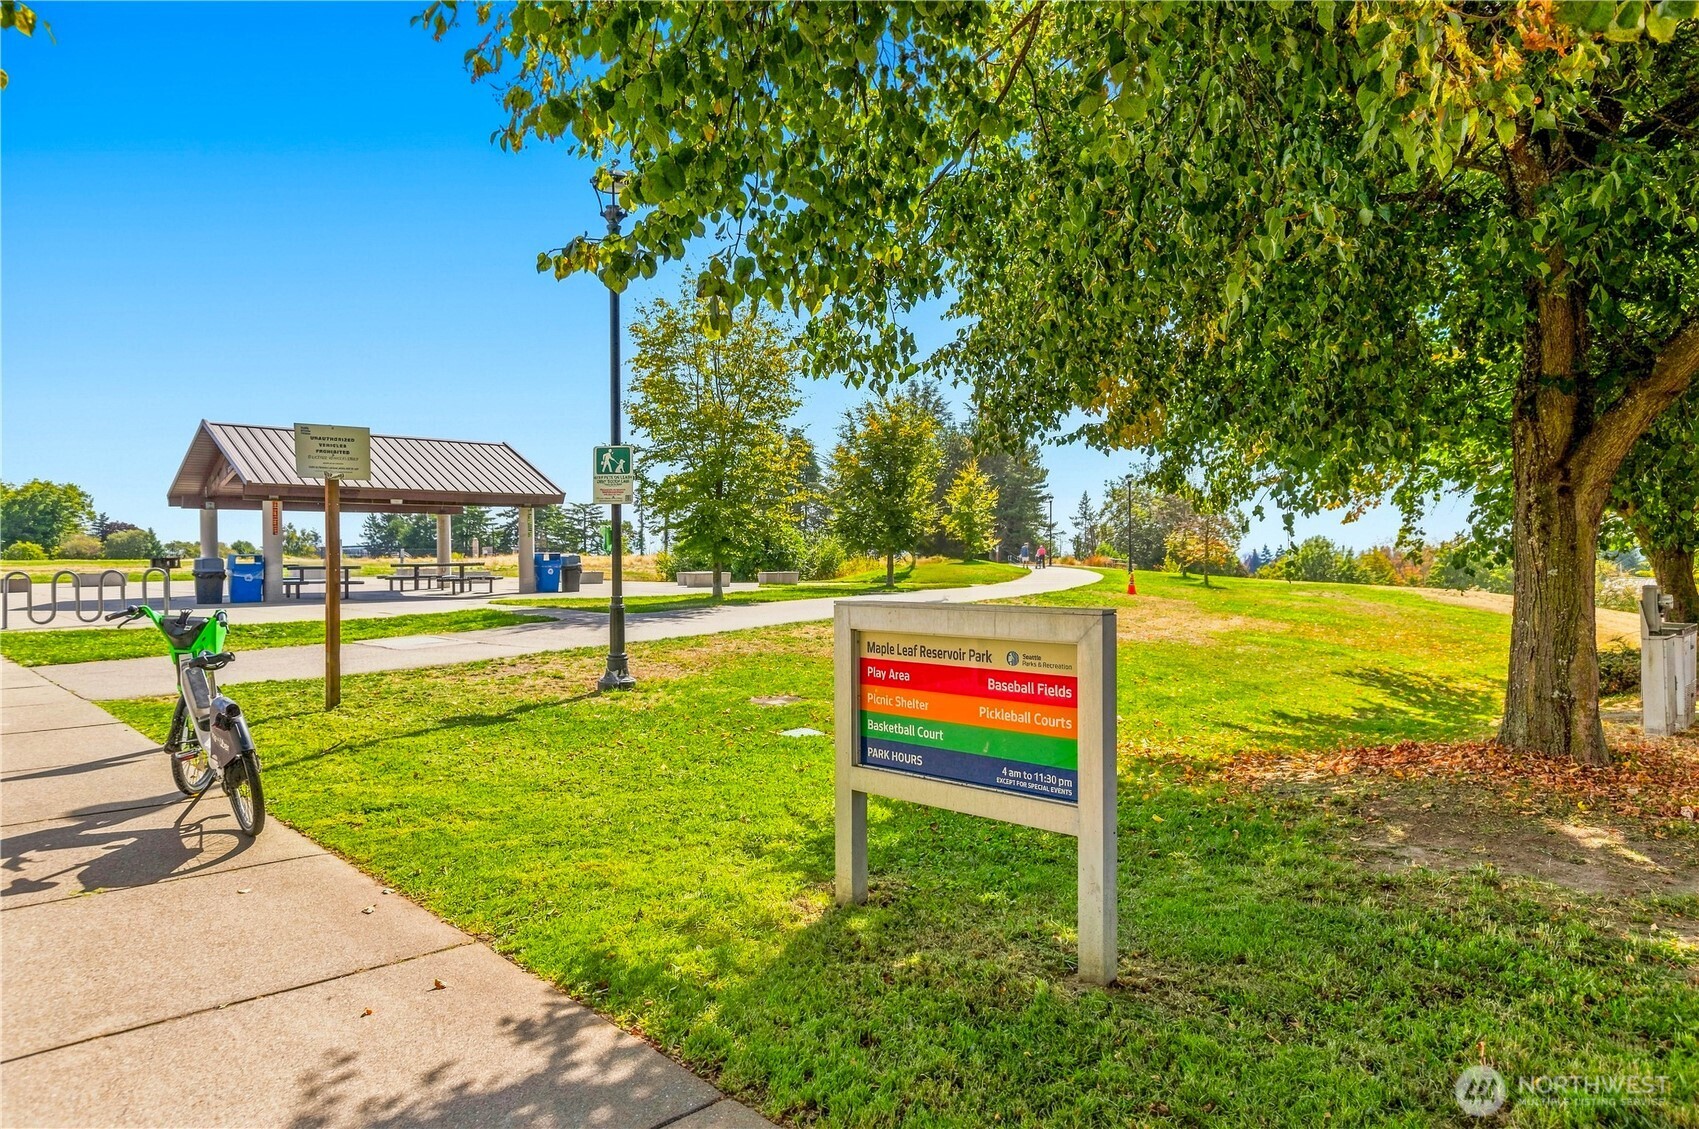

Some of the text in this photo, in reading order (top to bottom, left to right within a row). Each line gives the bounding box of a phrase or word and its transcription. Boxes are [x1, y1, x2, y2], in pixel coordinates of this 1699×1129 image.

[867, 641, 992, 663] Maple Leaf Reservoir Park
[1022, 653, 1041, 661] Seattle
[867, 666, 910, 681] Play Area
[1022, 660, 1036, 668] Parks
[1042, 662, 1073, 671] Recreation
[987, 678, 1072, 698] Baseball Fields
[867, 693, 929, 711] Picnic Shelter
[979, 706, 1072, 729] Pickleball Courts
[867, 719, 944, 741] Basketball Court
[867, 747, 923, 766] PARK HOURS
[996, 776, 1073, 796] EXCEPT FOR SPECIAL EVENTS
[1002, 767, 1073, 788] 4 am to 11:30 pm
